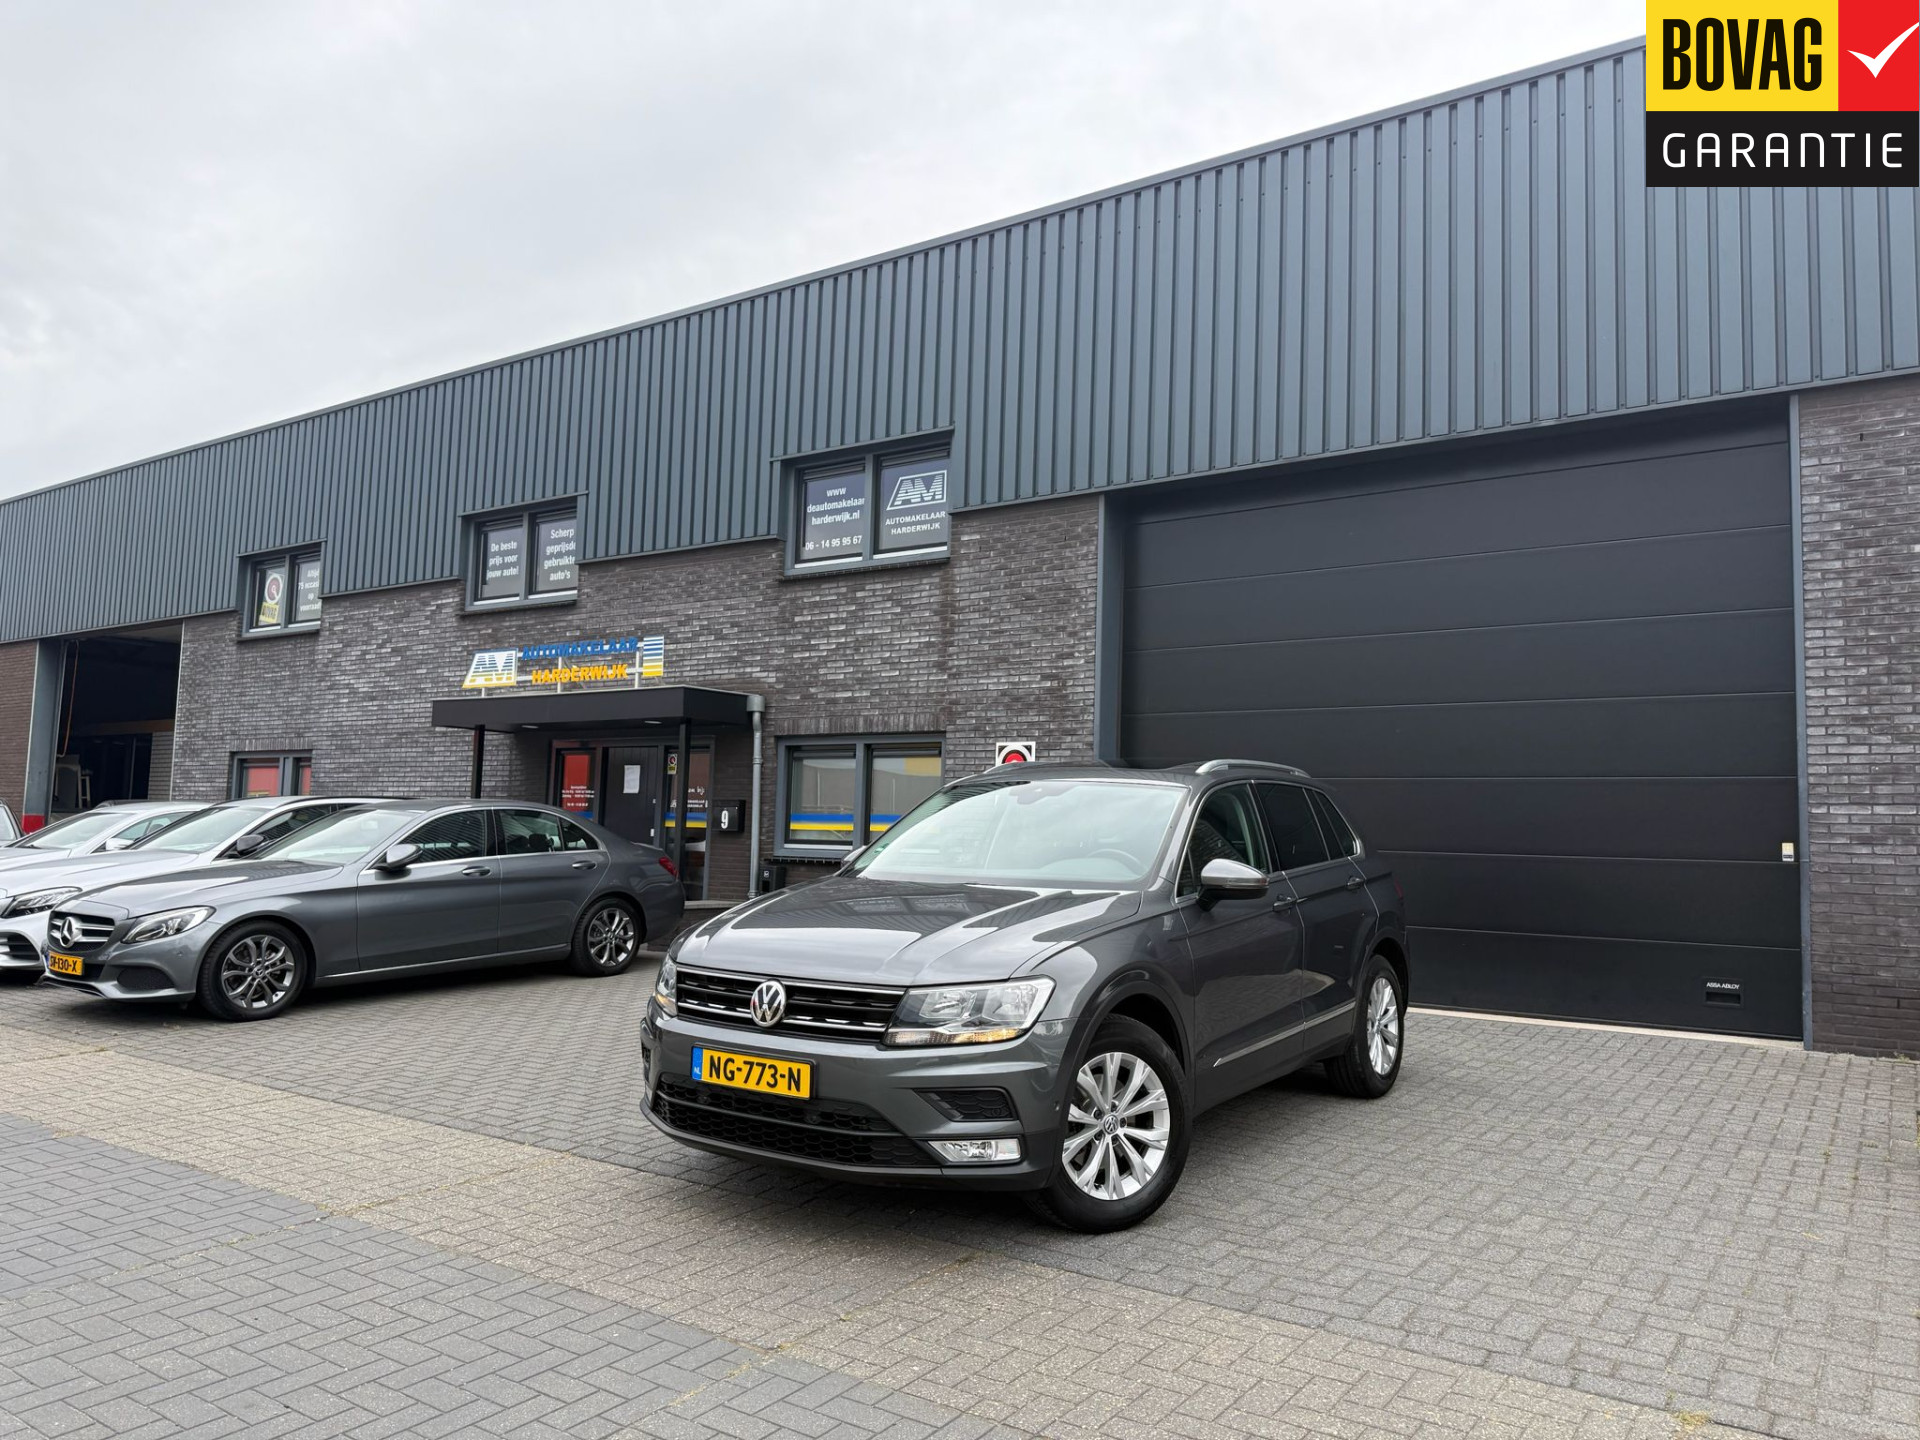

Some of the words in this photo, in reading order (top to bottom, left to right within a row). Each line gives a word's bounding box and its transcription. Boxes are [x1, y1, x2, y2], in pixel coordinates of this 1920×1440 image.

[826, 487, 846, 497] www
[807, 497, 865, 513] deautomakelaar
[811, 510, 860, 525] harderwijk.nl
[885, 511, 946, 526] AUTOMAKELAAR
[550, 528, 575, 539] Scherp
[891, 522, 941, 535] HARDERWIJK
[490, 543, 499, 552] De
[500, 541, 517, 551] beste
[805, 541, 814, 551] 06
[821, 539, 830, 549] 14
[831, 538, 841, 548] 95
[842, 537, 851, 546] 95
[852, 535, 862, 545] 67
[489, 555, 502, 567] prijs
[504, 554, 518, 563] voor
[486, 569, 501, 580] jouw
[549, 570, 571, 581] auto's
[522, 637, 638, 660] AUTOMAKELAAR
[532, 663, 629, 685] HARDERWIJK
[721, 810, 729, 829] 9
[693, 1067, 701, 1075] NL
[709, 1055, 801, 1092] NG-773-N
